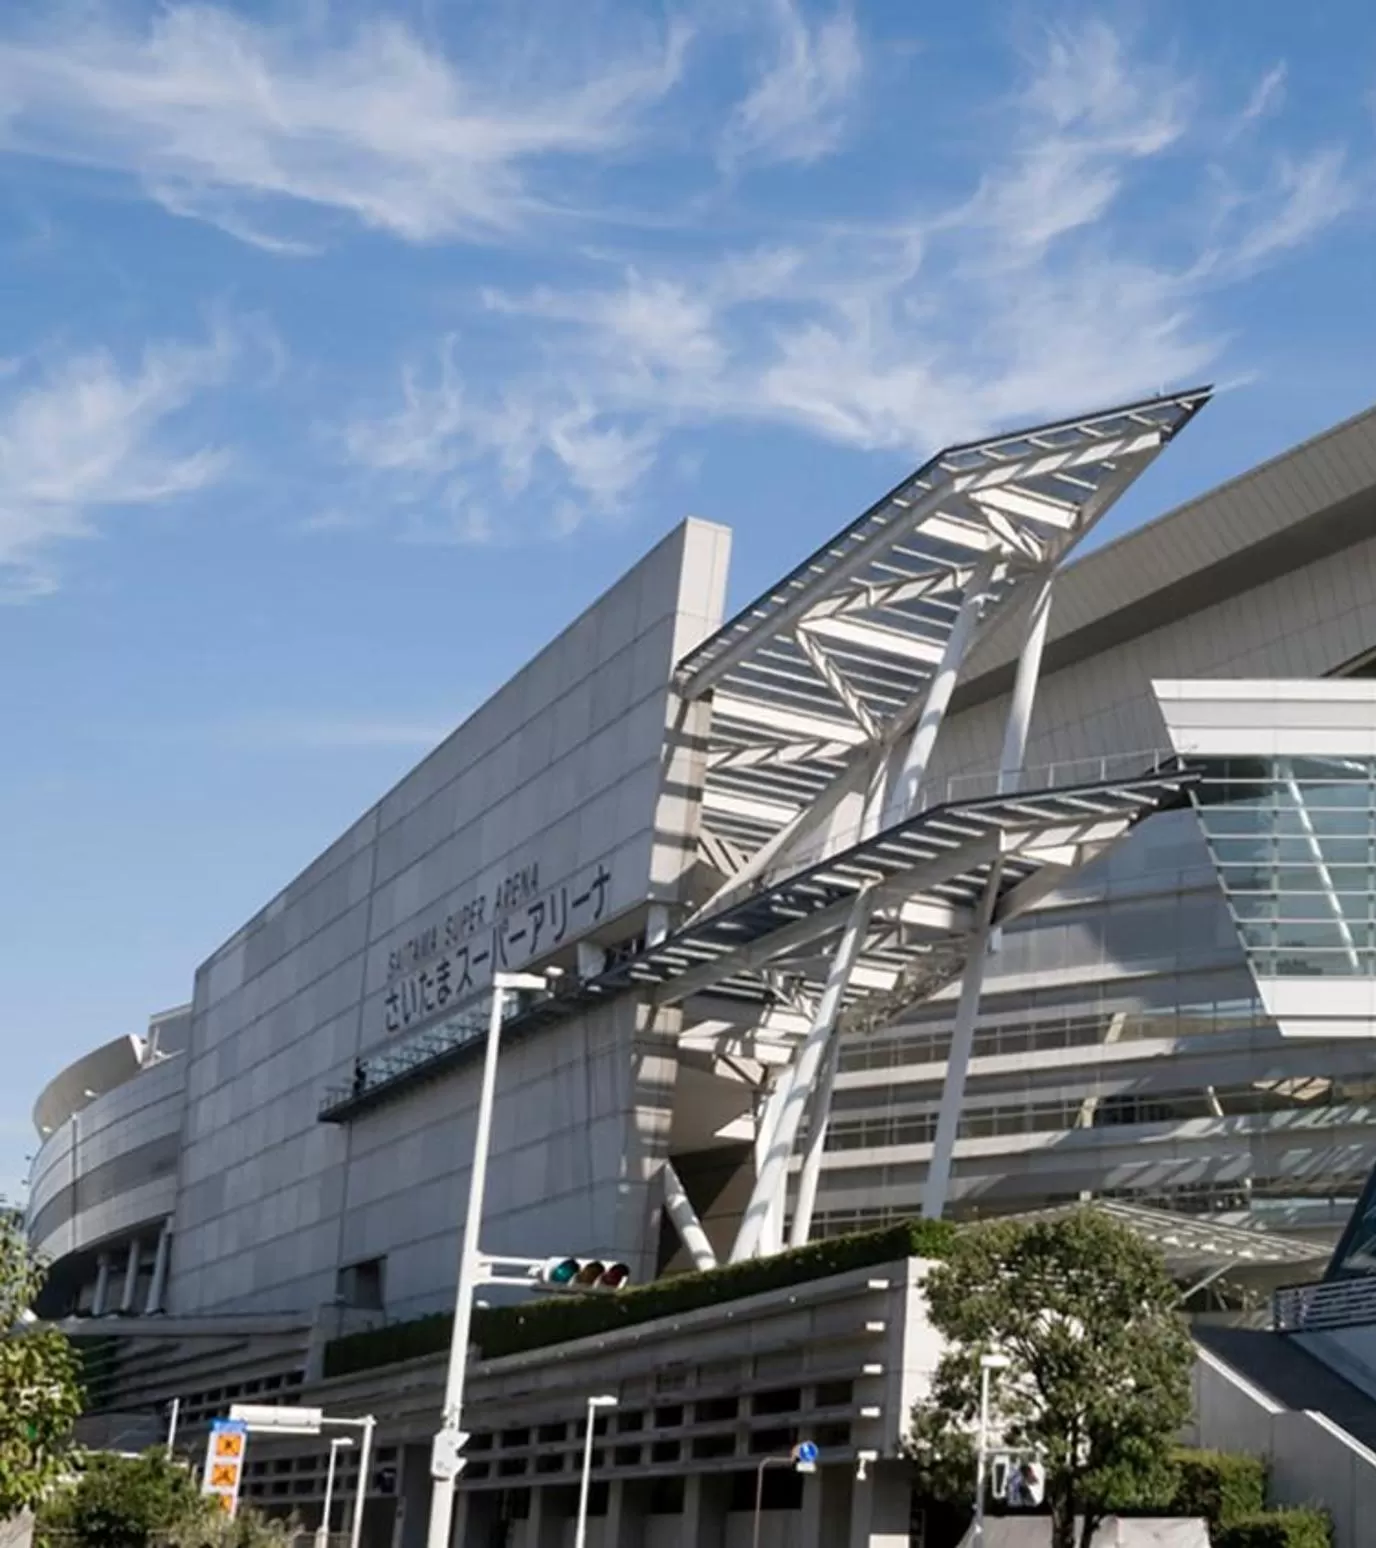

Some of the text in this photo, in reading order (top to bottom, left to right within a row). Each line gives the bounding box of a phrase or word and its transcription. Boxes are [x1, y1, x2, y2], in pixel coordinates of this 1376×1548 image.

[384, 863, 611, 1032] さいたまスーパーアリーナ
[444, 894, 486, 947] SUPER
[494, 861, 540, 911] ARENA
